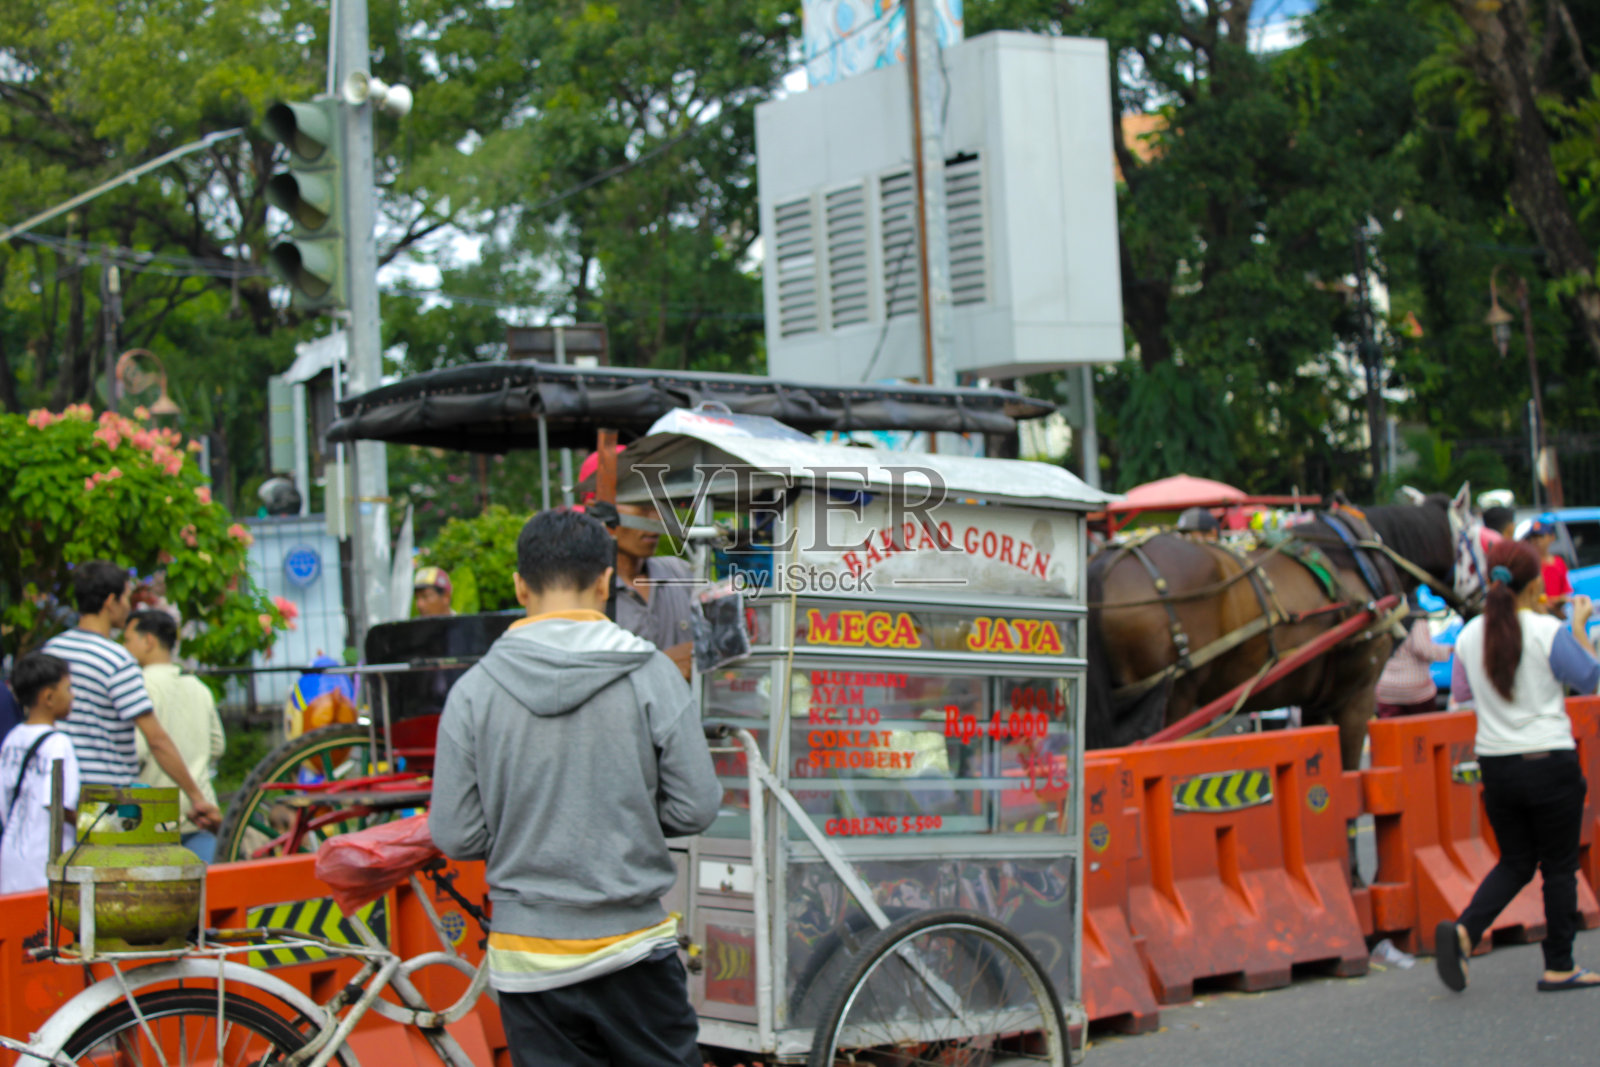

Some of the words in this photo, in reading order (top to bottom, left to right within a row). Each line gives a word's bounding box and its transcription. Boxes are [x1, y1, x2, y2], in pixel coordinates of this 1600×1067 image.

[964, 526, 1050, 580] GOREN
[807, 609, 921, 649] MEGA
[967, 617, 1065, 655] JAYA
[810, 687, 864, 705] AYAM
[847, 711, 880, 726] IJO
[944, 704, 983, 745] Rp.
[987, 709, 1049, 742] 4.000
[808, 730, 893, 748] COKLAT
[808, 750, 915, 769] STROBERY
[825, 817, 898, 836] GORENG
